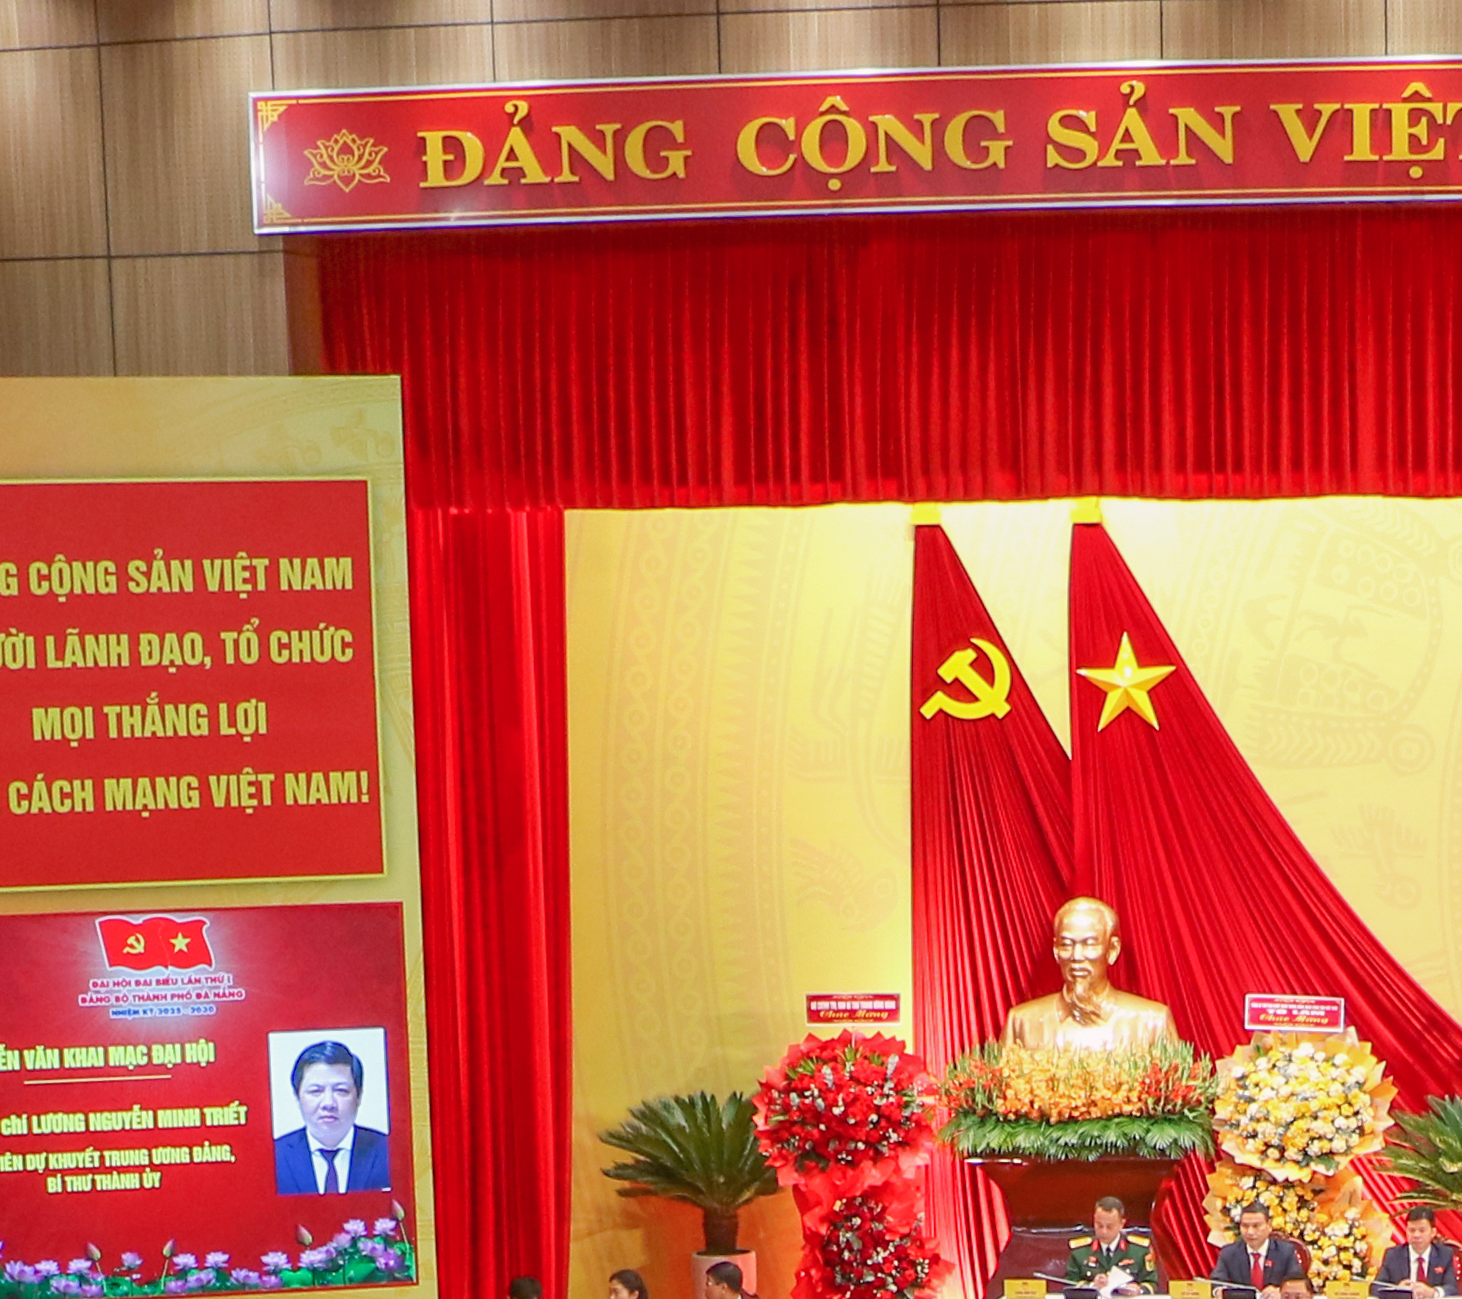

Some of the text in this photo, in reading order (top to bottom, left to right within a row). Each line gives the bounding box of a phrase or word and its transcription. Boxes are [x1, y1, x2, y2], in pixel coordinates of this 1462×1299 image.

[419, 84, 691, 187] ĐẢNG
[737, 95, 1013, 190] CỘNG
[1047, 80, 1241, 168] SẢN
[29, 554, 117, 602] CỘNG
[128, 548, 193, 593] SẢN
[203, 552, 269, 598] VIỆT
[279, 557, 352, 590] NAM
[46, 628, 129, 668] LÃNH
[139, 632, 211, 673] ĐẠO,
[220, 618, 259, 664] TỔ
[270, 623, 353, 663] CHỨC
[32, 692, 266, 747] MỌI THẮNG LỢI
[9, 774, 94, 814] CÁCH
[104, 776, 200, 817] MẠNG
[209, 767, 274, 813] VIỆT
[285, 771, 369, 805] NAM!
[23, 1045, 60, 1070] VĂN
[63, 1046, 105, 1068] KHAI
[107, 1043, 149, 1070] MẠC
[152, 1045, 181, 1069] ĐẠI
[185, 1039, 216, 1068] HỘI
[157, 1108, 201, 1128] MINH
